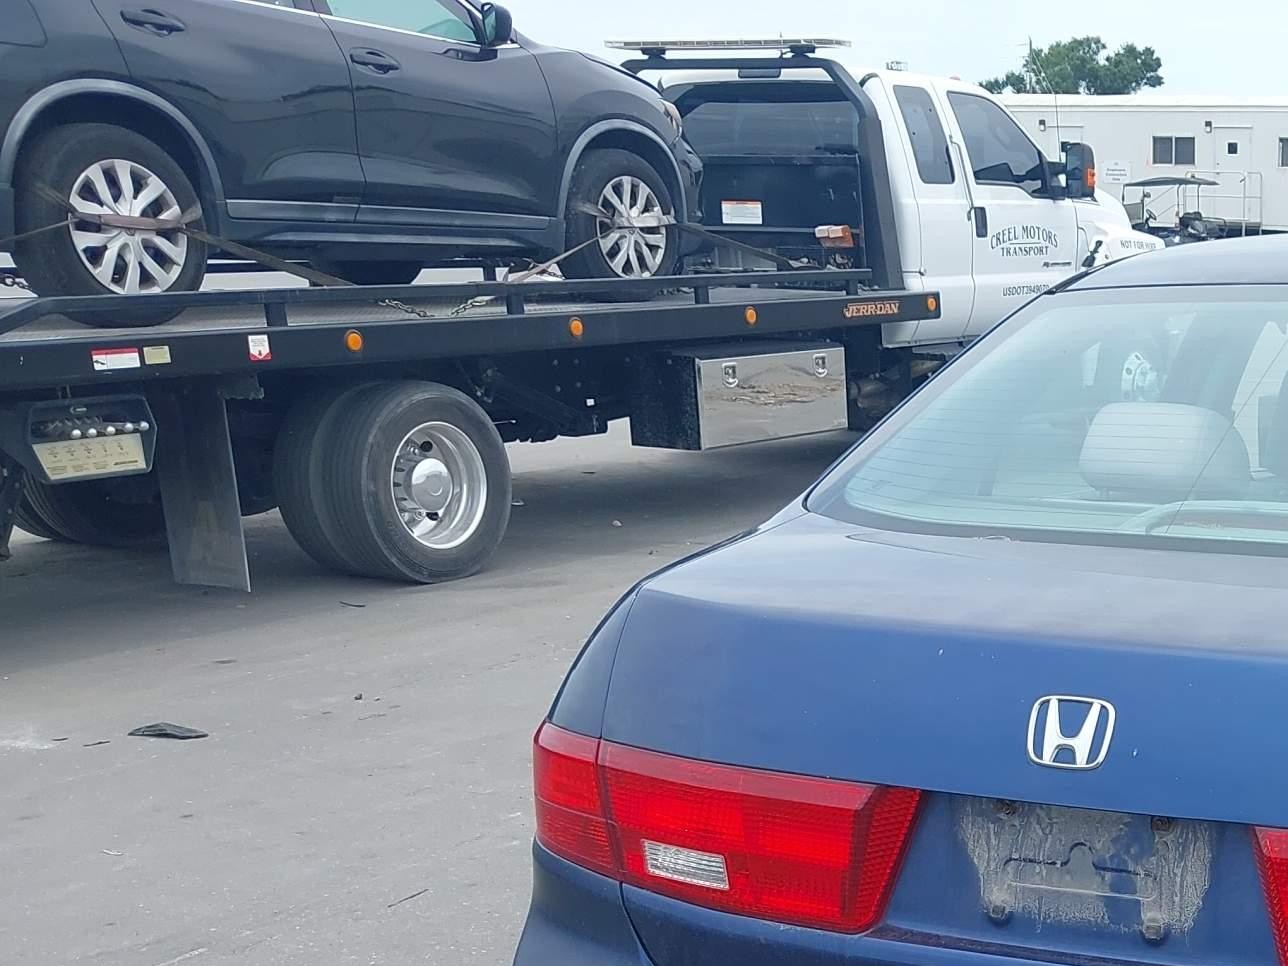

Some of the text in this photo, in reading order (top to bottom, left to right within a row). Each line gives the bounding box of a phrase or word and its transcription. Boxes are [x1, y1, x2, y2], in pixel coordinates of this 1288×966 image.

[990, 225, 1058, 250] CREEL MOTORS
[1120, 239, 1132, 249] NOT
[1001, 246, 1049, 258] TRANSPORT
